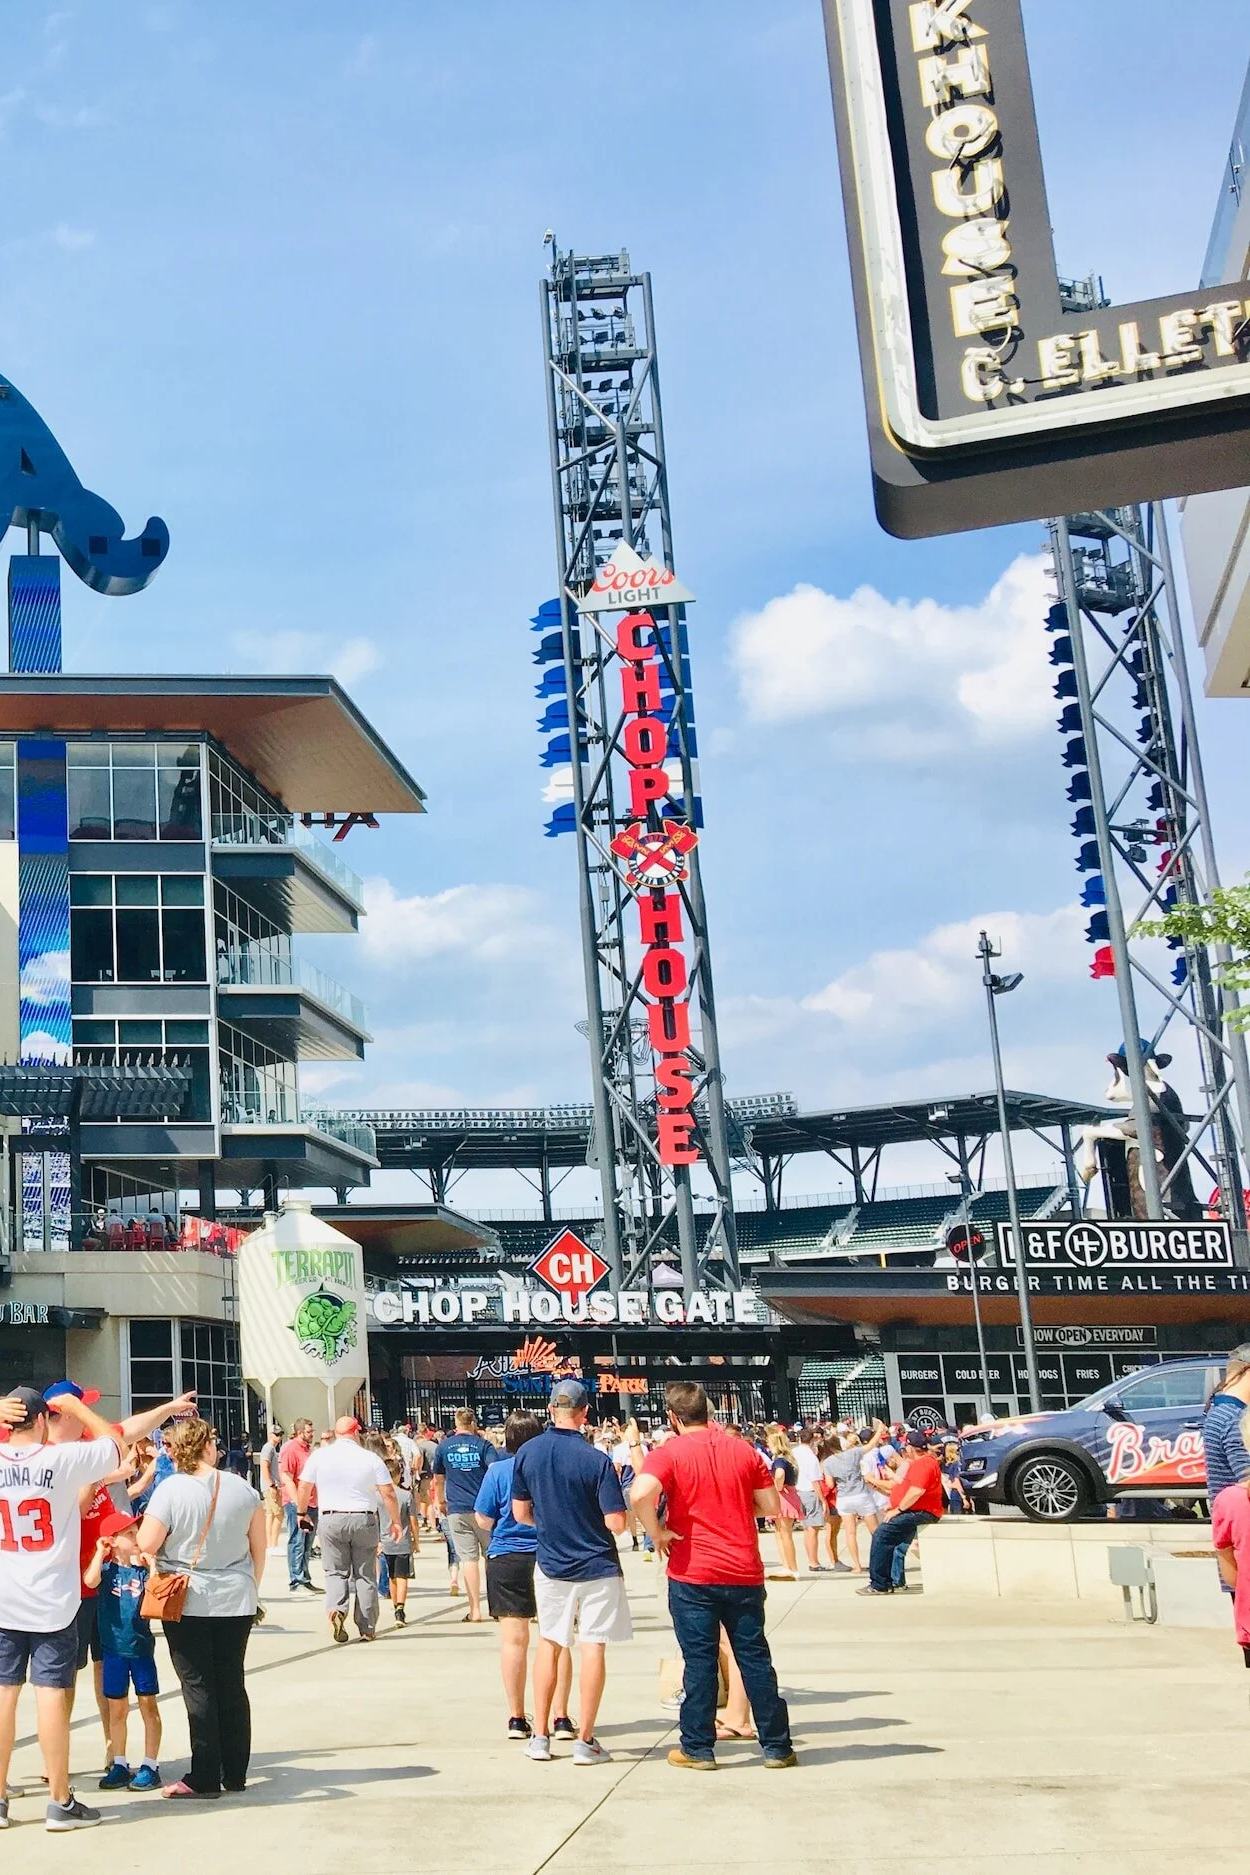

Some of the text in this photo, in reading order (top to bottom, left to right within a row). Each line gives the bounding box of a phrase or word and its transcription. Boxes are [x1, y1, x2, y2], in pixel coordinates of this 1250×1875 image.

[1037, 298, 1250, 389] ELLET
[592, 563, 676, 593] Coors
[608, 586, 662, 605] LIGHT
[617, 612, 670, 817] CHOP
[638, 893, 698, 1165] HOUSE
[1109, 1230, 1225, 1260] BURGER
[271, 1249, 356, 1290] TERRAPIN
[549, 1252, 595, 1285] CH
[1052, 1275, 1109, 1291] TIME
[1121, 1275, 1162, 1290] ALL
[1173, 1275, 1217, 1290] THE
[9, 1301, 50, 1325] BAR
[373, 1290, 760, 1323] CHOP HOUSE GATE
[1058, 1329, 1087, 1341] OPEN
[1093, 1328, 1144, 1341] EVERYDAY
[502, 1373, 649, 1395] SUNTST PARK
[901, 1369, 939, 1380] BURGERS
[955, 1369, 1001, 1380] COLD BER
[1017, 1368, 1030, 1379] HO
[1076, 1368, 1100, 1379] FRIES
[447, 1452, 481, 1463] COSTA
[1106, 1421, 1205, 1484] Bra
[34, 1468, 54, 1489] JR.
